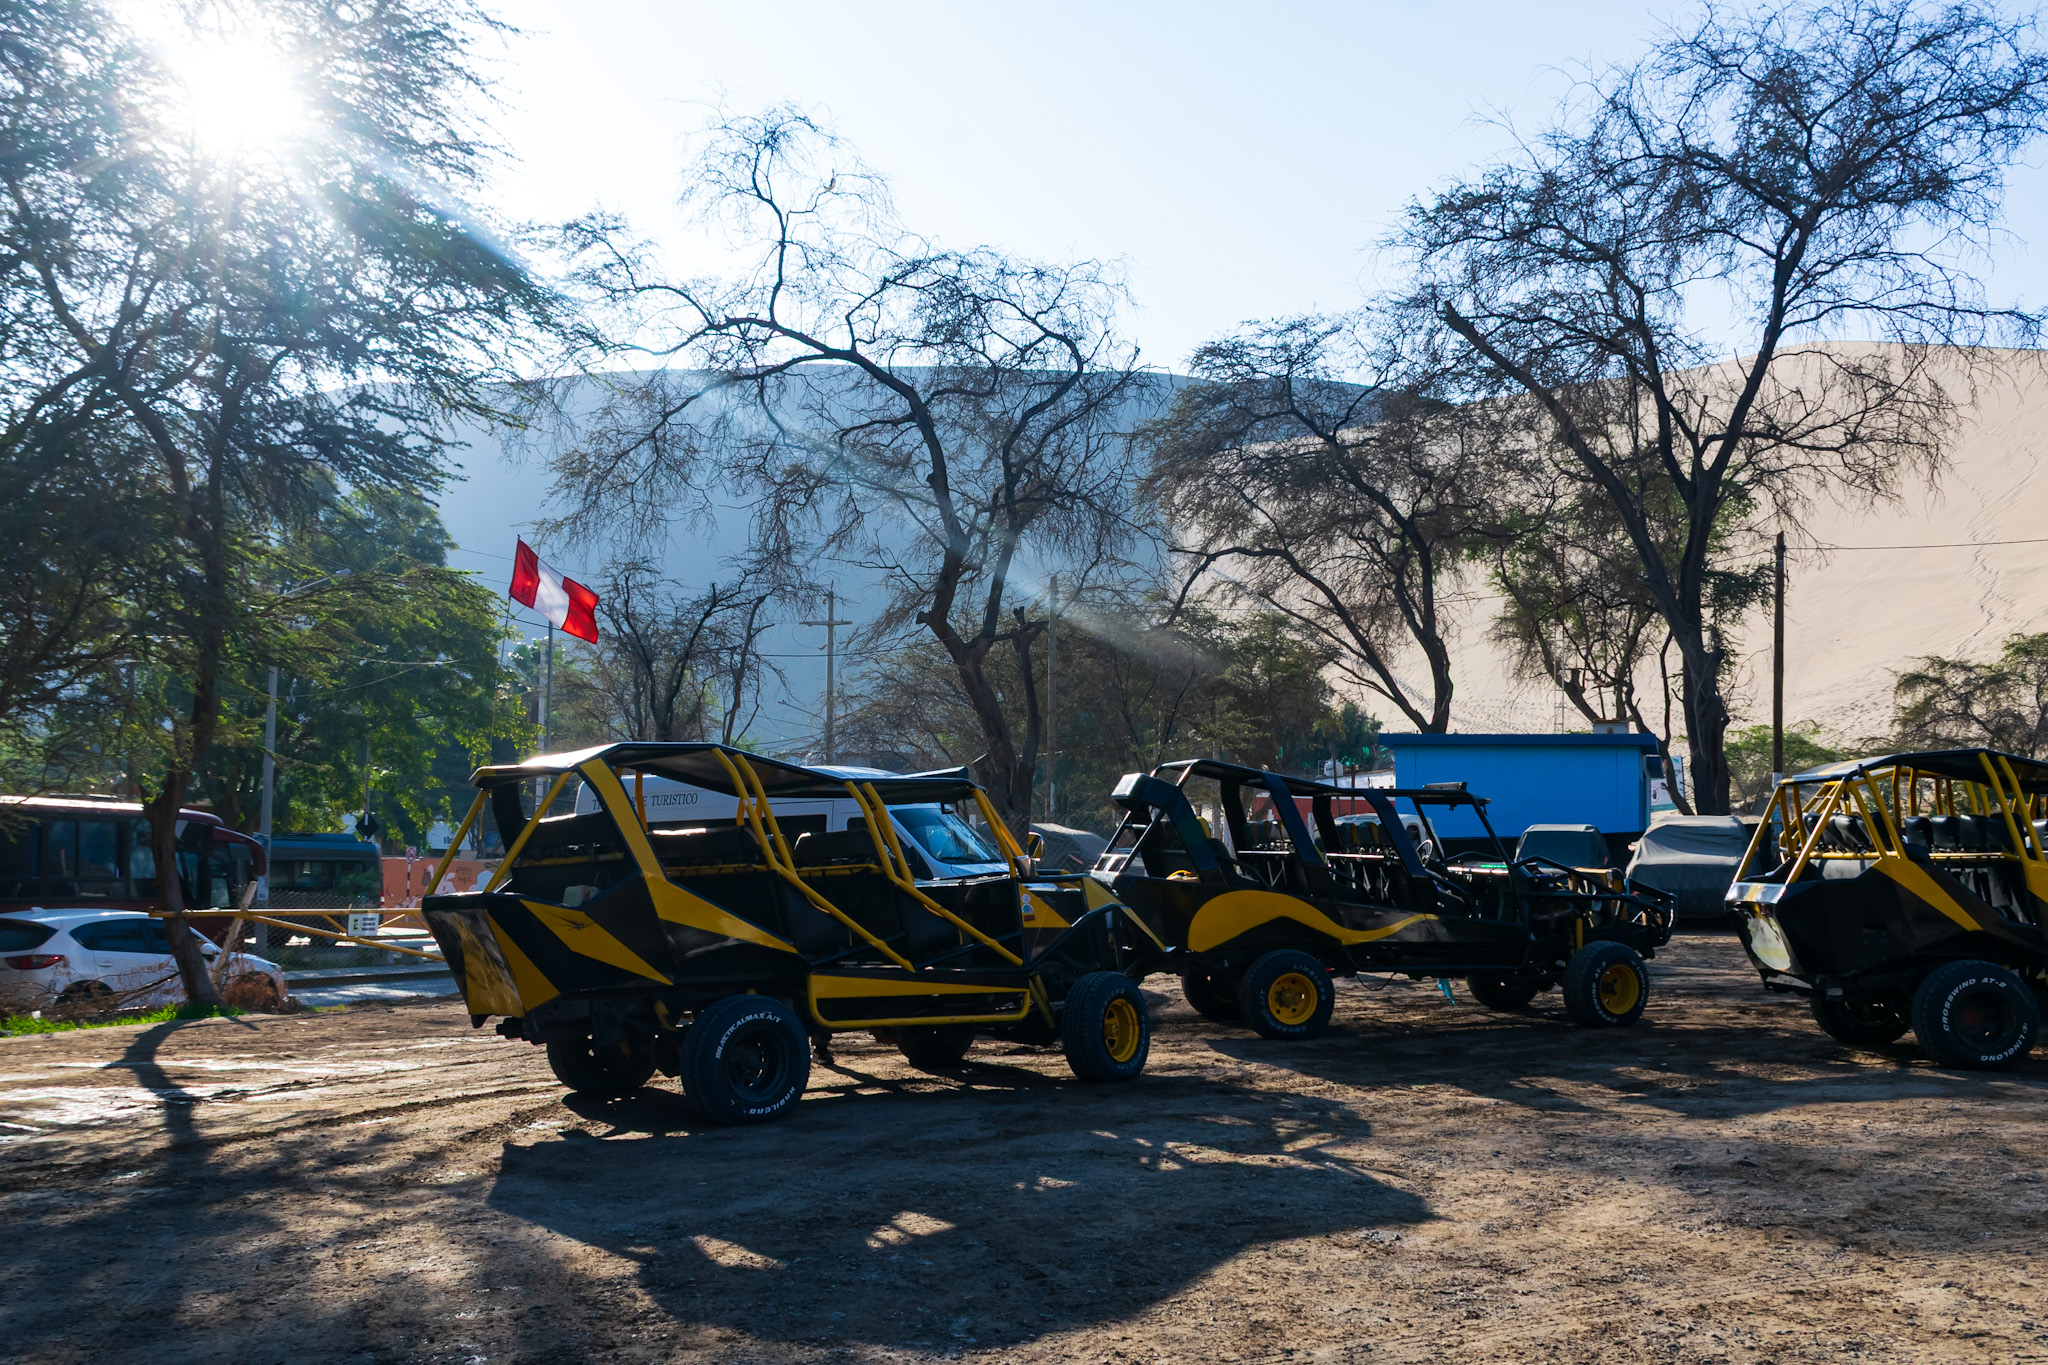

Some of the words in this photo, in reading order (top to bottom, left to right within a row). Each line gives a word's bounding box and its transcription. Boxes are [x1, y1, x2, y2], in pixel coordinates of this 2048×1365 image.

[651, 793, 698, 807] TURISTICO
[1591, 982, 1618, 1024] CROSSWIND
[1941, 978, 1977, 1032] CROSSWIND
[1981, 977, 2007, 989] AT-2
[1980, 1033, 2026, 1062] LINGLONG
